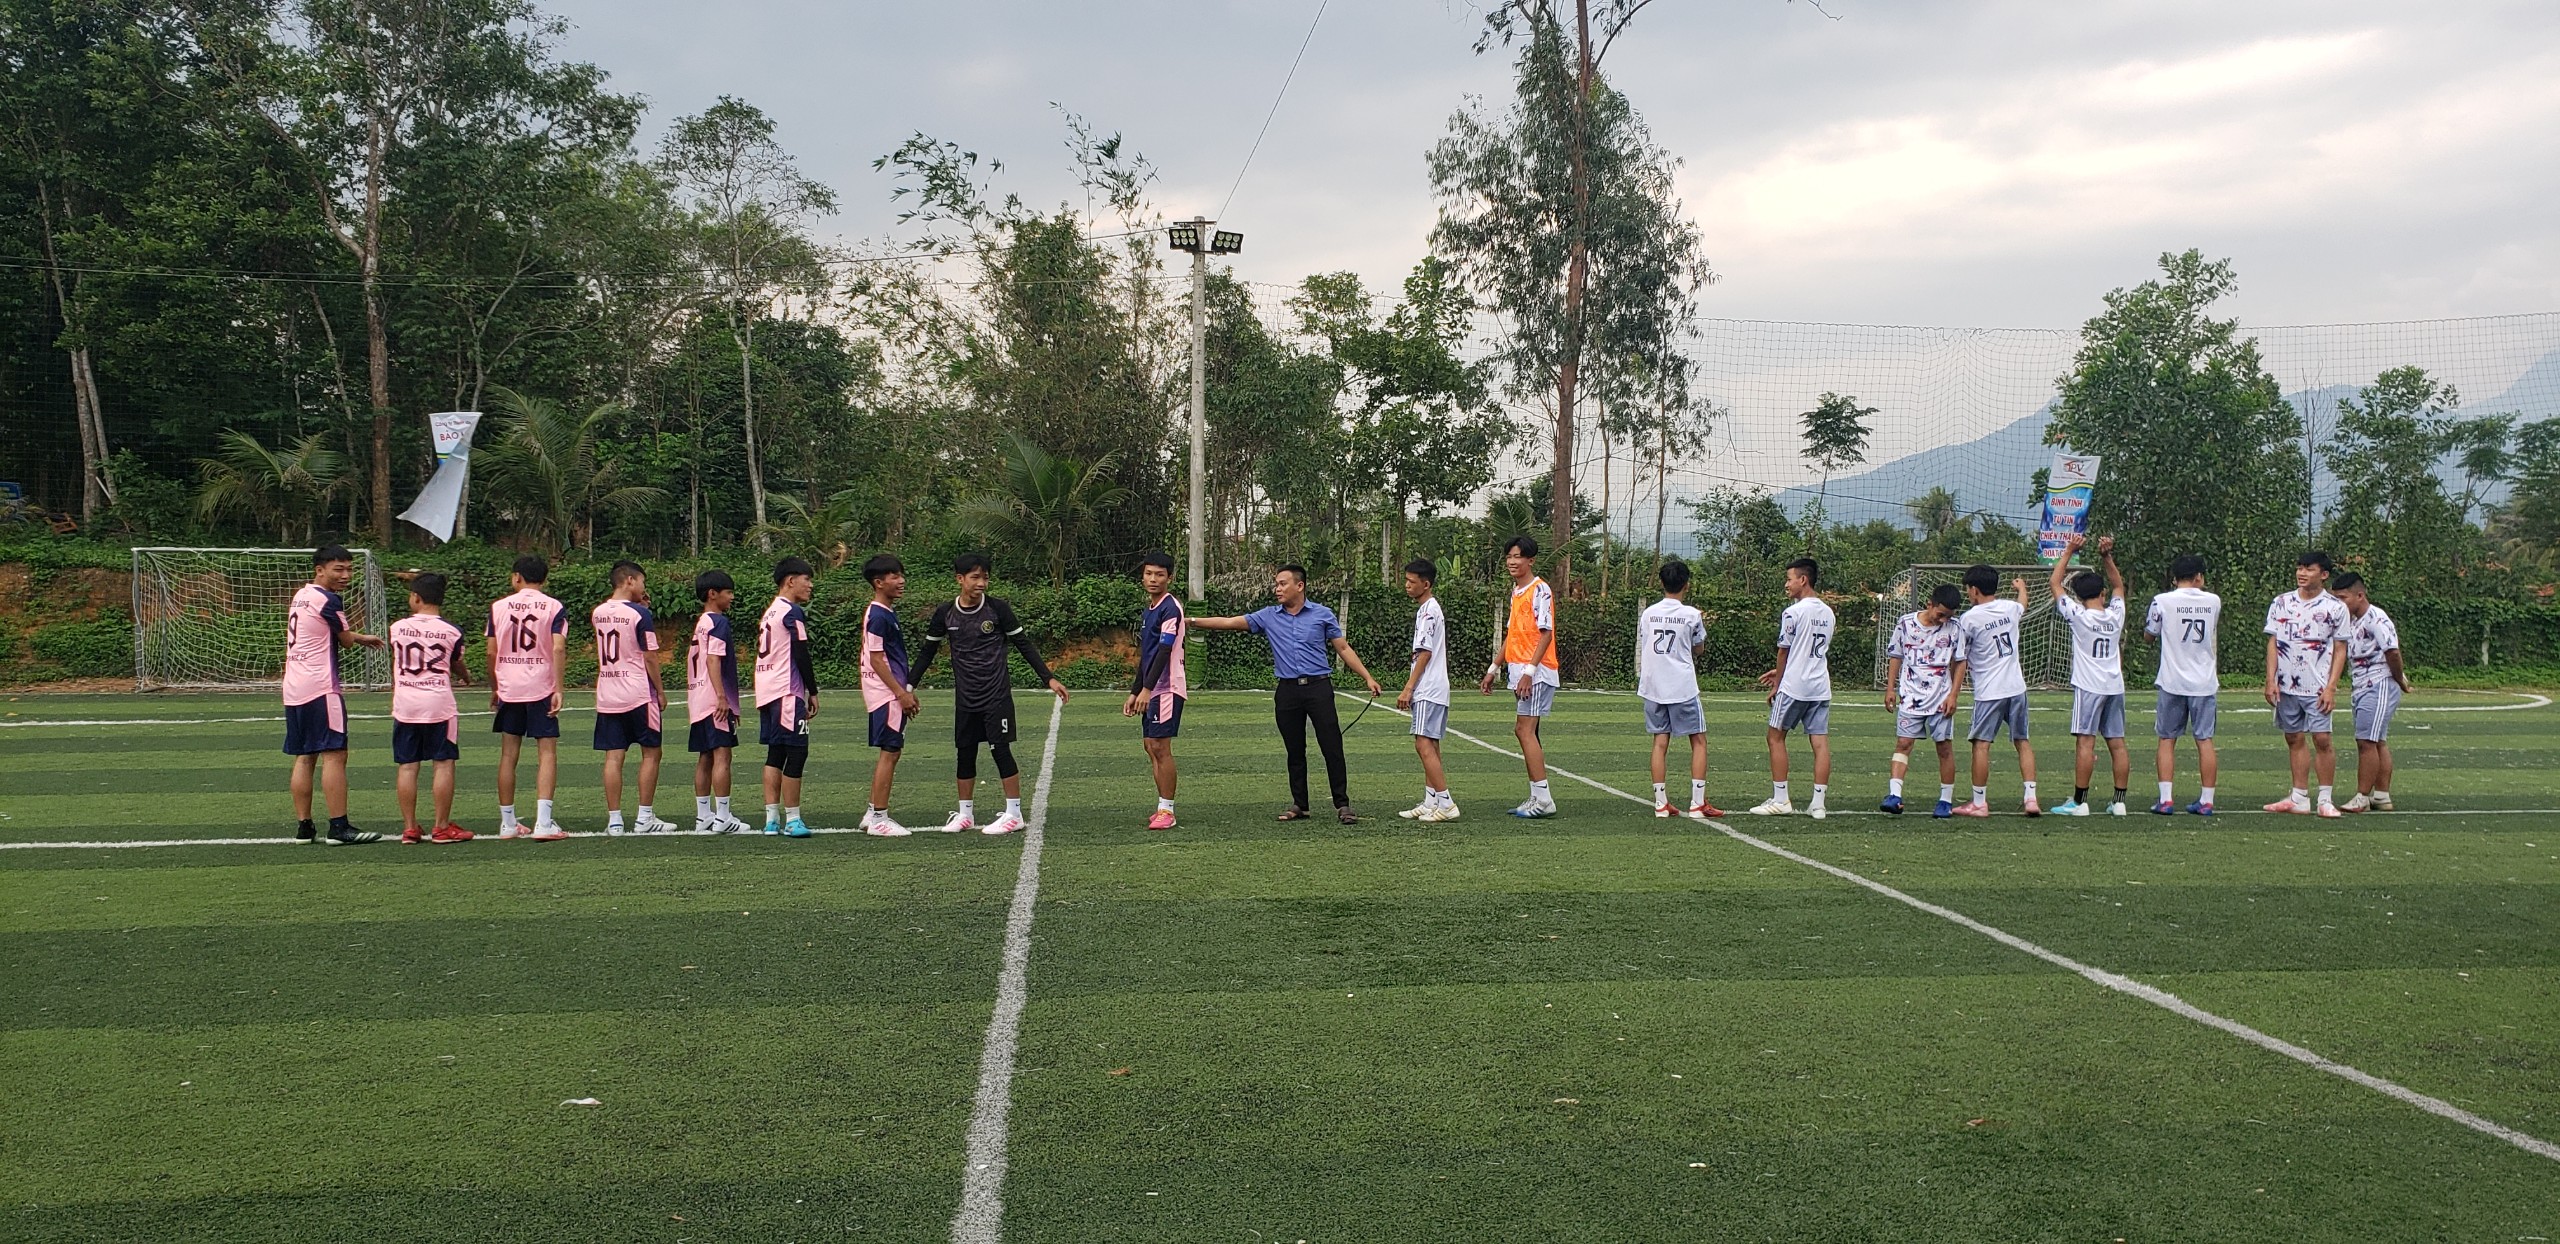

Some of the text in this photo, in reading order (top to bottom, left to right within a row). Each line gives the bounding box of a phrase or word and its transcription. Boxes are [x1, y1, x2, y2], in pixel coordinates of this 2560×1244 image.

[398, 627, 421, 638] Minh
[510, 613, 539, 653] 16
[1653, 629, 1677, 655] 27
[2181, 618, 2205, 644] 79
[598, 628, 620, 666] 10
[1809, 632, 1827, 658] 12
[1992, 631, 2014, 659] 19
[397, 641, 446, 676] 102
[536, 657, 545, 665] FC
[1002, 718, 1008, 733] 9
